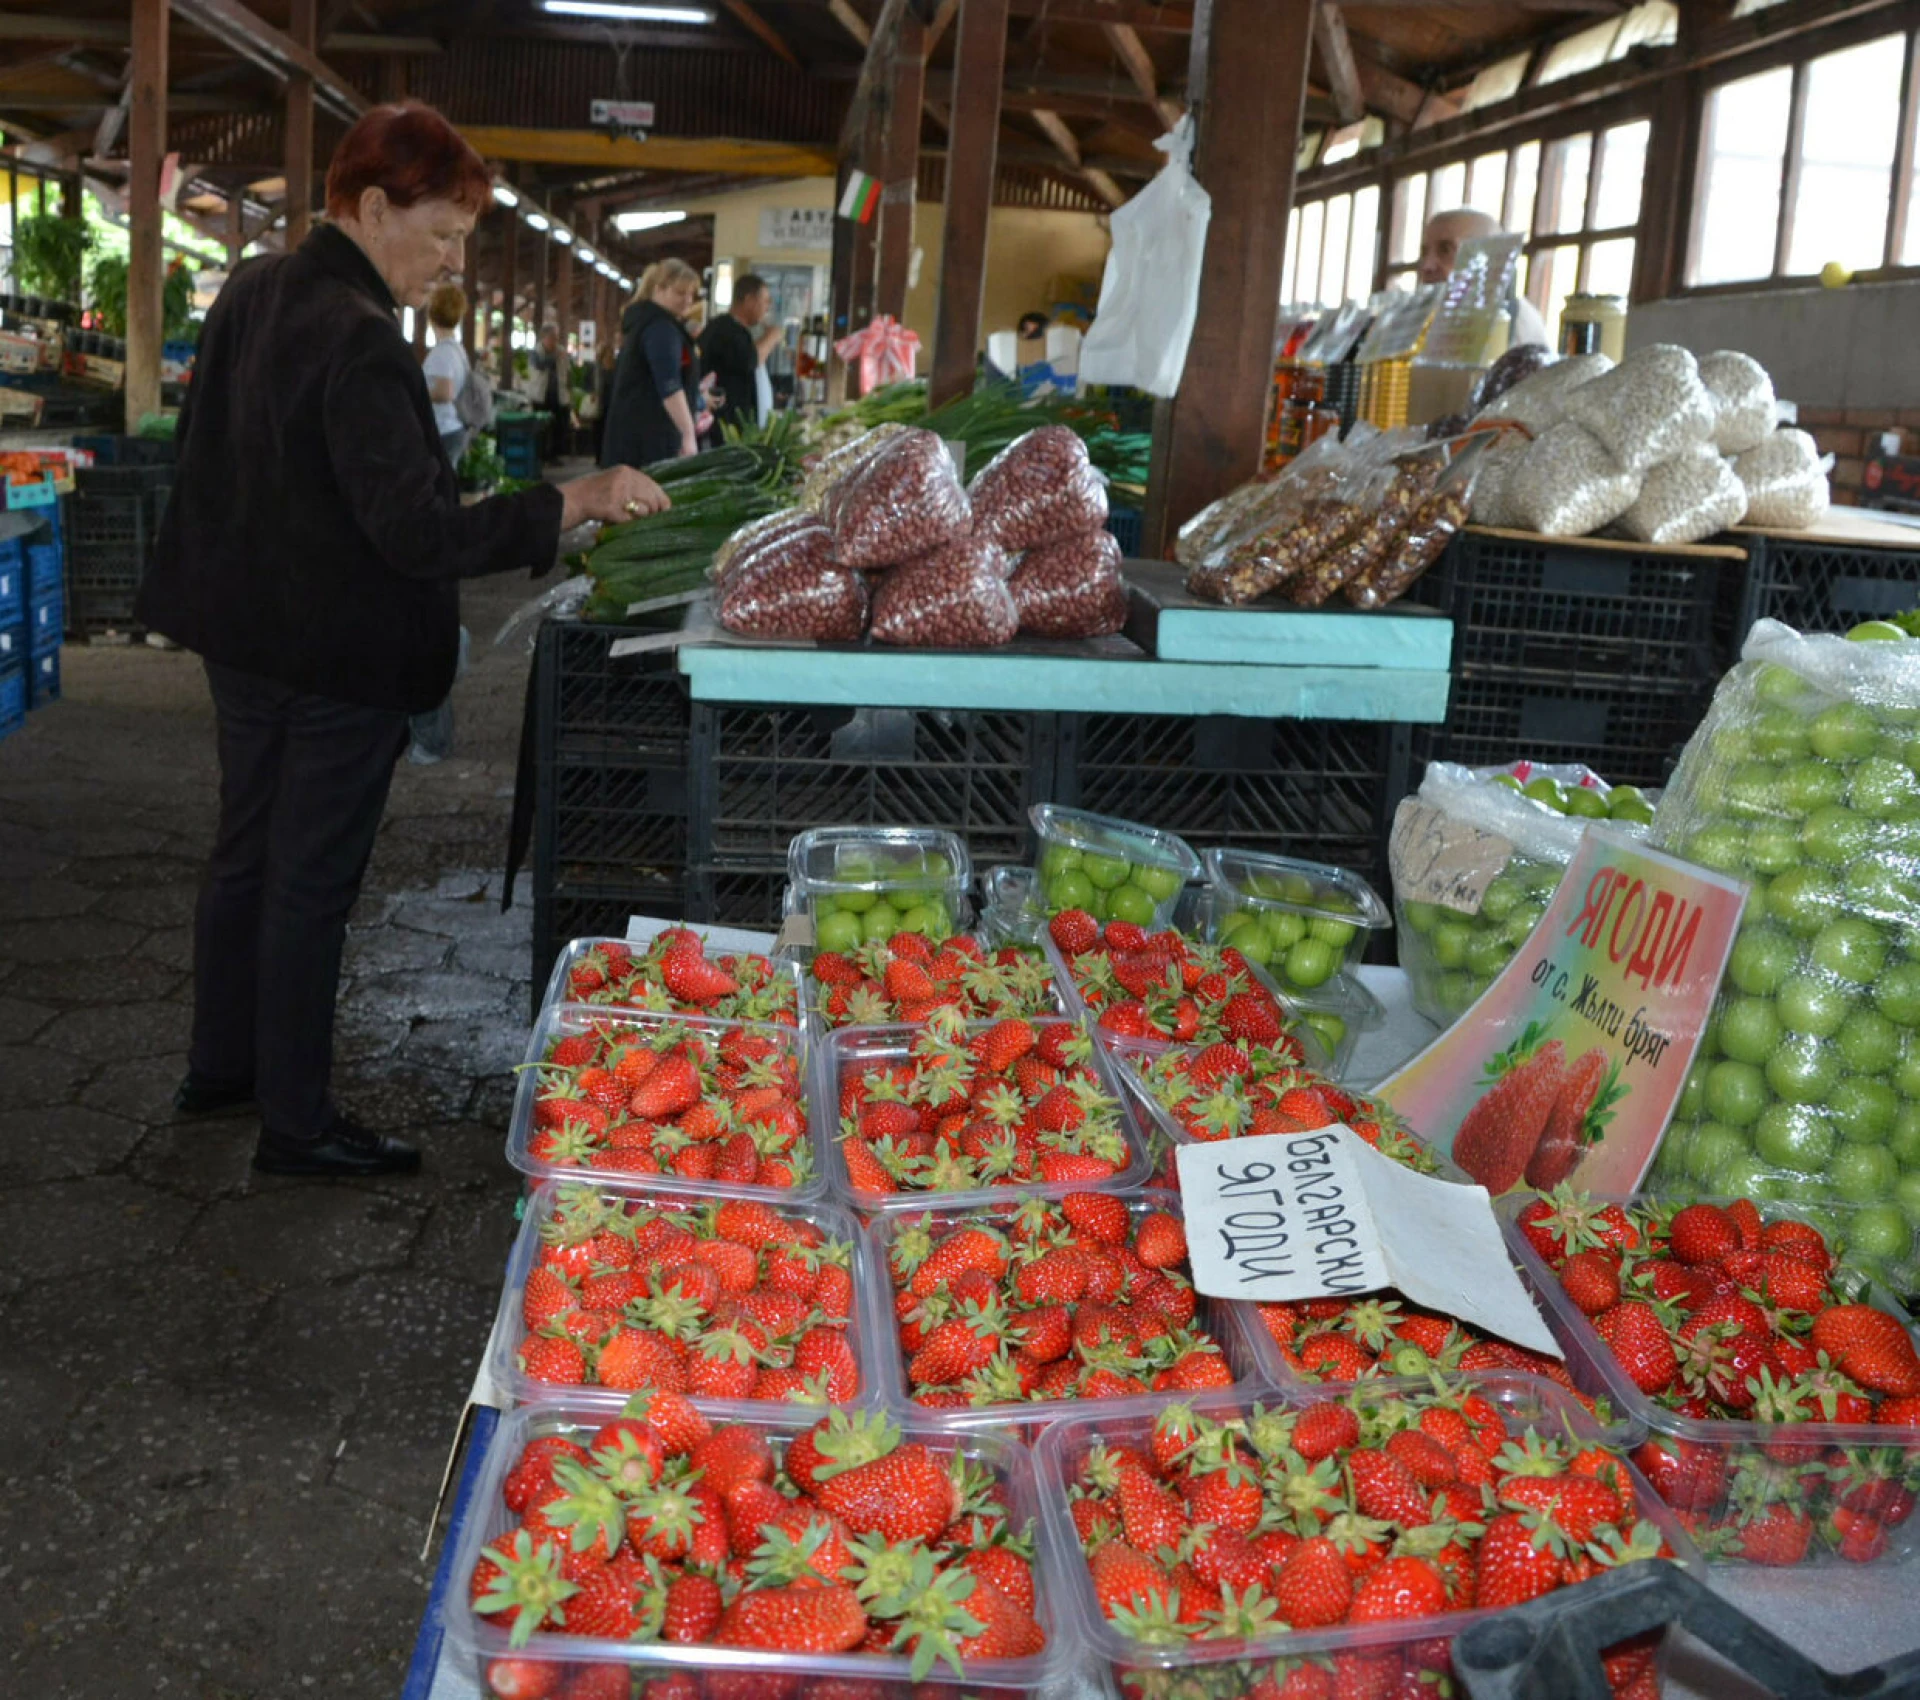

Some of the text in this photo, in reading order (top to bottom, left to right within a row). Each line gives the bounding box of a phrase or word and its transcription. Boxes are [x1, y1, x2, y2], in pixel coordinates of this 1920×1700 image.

[1566, 866, 1704, 991] ЯГОДИ
[1623, 1006, 1671, 1069] бряг
[1217, 1162, 1296, 1283] ЯГОДИ
